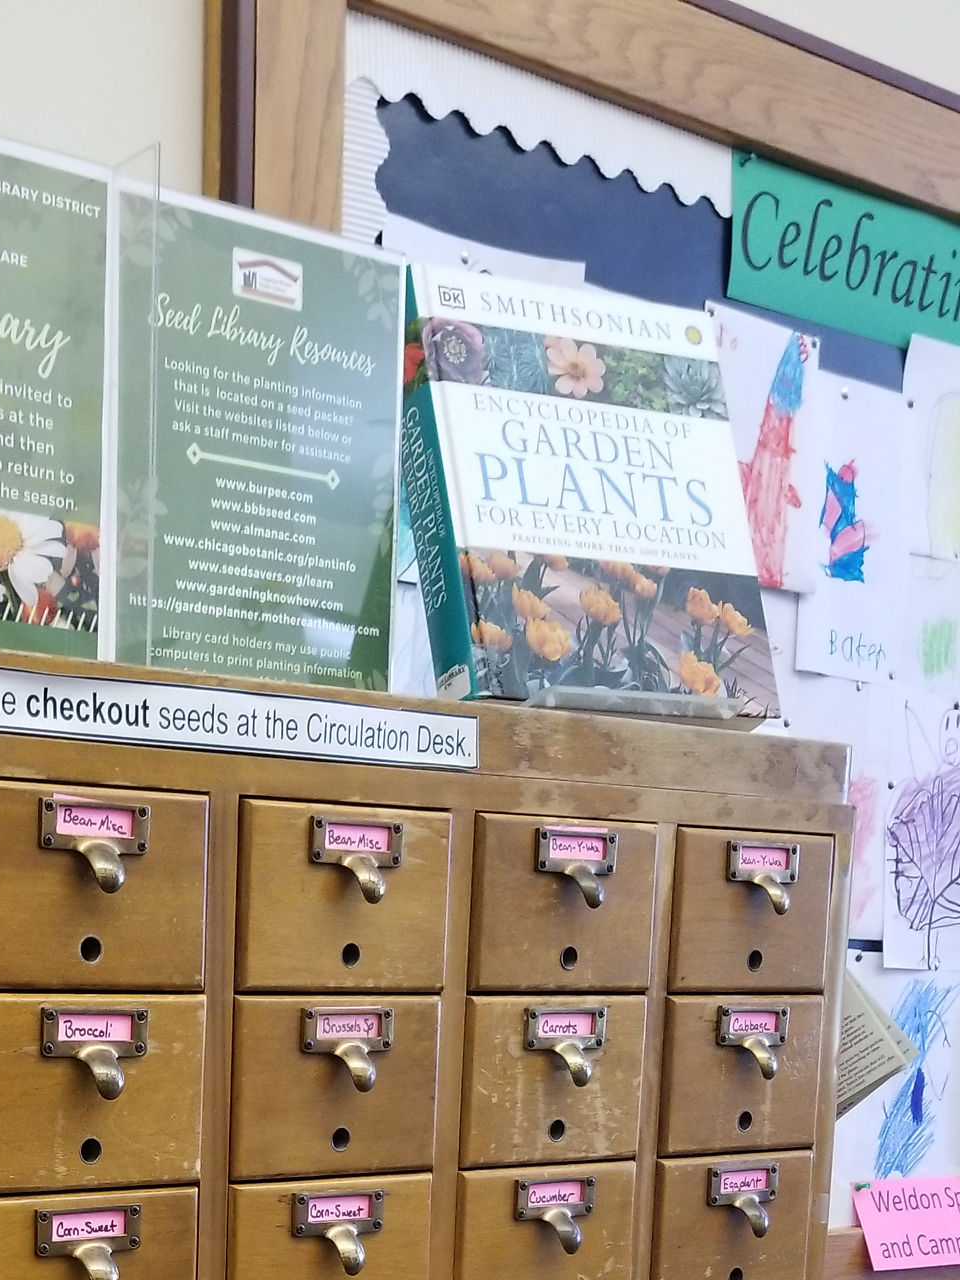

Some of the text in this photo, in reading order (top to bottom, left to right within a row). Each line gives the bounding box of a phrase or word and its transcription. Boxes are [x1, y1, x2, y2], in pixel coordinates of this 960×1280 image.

[42, 193, 101, 218] DISTRICT
[442, 291, 673, 342] DK SMITHSONIAN
[148, 292, 376, 377] Seed Library Resources
[0, 379, 52, 407] invited
[57, 391, 73, 408] to
[164, 356, 362, 409] Looking for the planting information
[9, 409, 25, 424] at
[29, 411, 53, 429] the
[474, 393, 692, 439] ENCYCLOPEDIA OF
[20, 436, 54, 456] then
[501, 419, 675, 471] GARDEN
[8, 459, 56, 481] return
[60, 469, 75, 485] to
[24, 490, 78, 511] season.
[215, 476, 313, 503] www.burpee.com
[474, 452, 713, 528] PLANTS
[211, 497, 317, 524] www.bbbseed.com
[406, 407, 447, 609] GARDEN PLANTS
[211, 519, 316, 546] www.almanac.com
[476, 505, 728, 549] FOR EVERY LOCATION
[164, 534, 356, 572] www.chicagobotanic.org/plantinfo
[189, 559, 334, 589] www.seedsavers.org/learn
[176, 580, 343, 612] www.gardeningknowhow.com
[26, 687, 150, 729] checkout
[159, 702, 228, 736] seeds
[237, 713, 259, 738] at
[265, 713, 298, 742] the
[306, 713, 410, 753] Circulation
[416, 723, 472, 758] Desk.
[63, 807, 128, 834] Bean-Misc
[328, 830, 383, 851] Bean-Misc
[63, 1020, 113, 1040] Broccoli
[321, 1018, 362, 1034] Brussels
[541, 1020, 577, 1034] Carrots
[731, 1019, 771, 1034] Cabbage
[528, 1189, 574, 1204] Cucumber
[870, 1187, 942, 1213] Weldon
[309, 1203, 364, 1219] Corn-Sweet
[56, 1219, 118, 1237] Corn-Sweet
[880, 1234, 915, 1259] and
